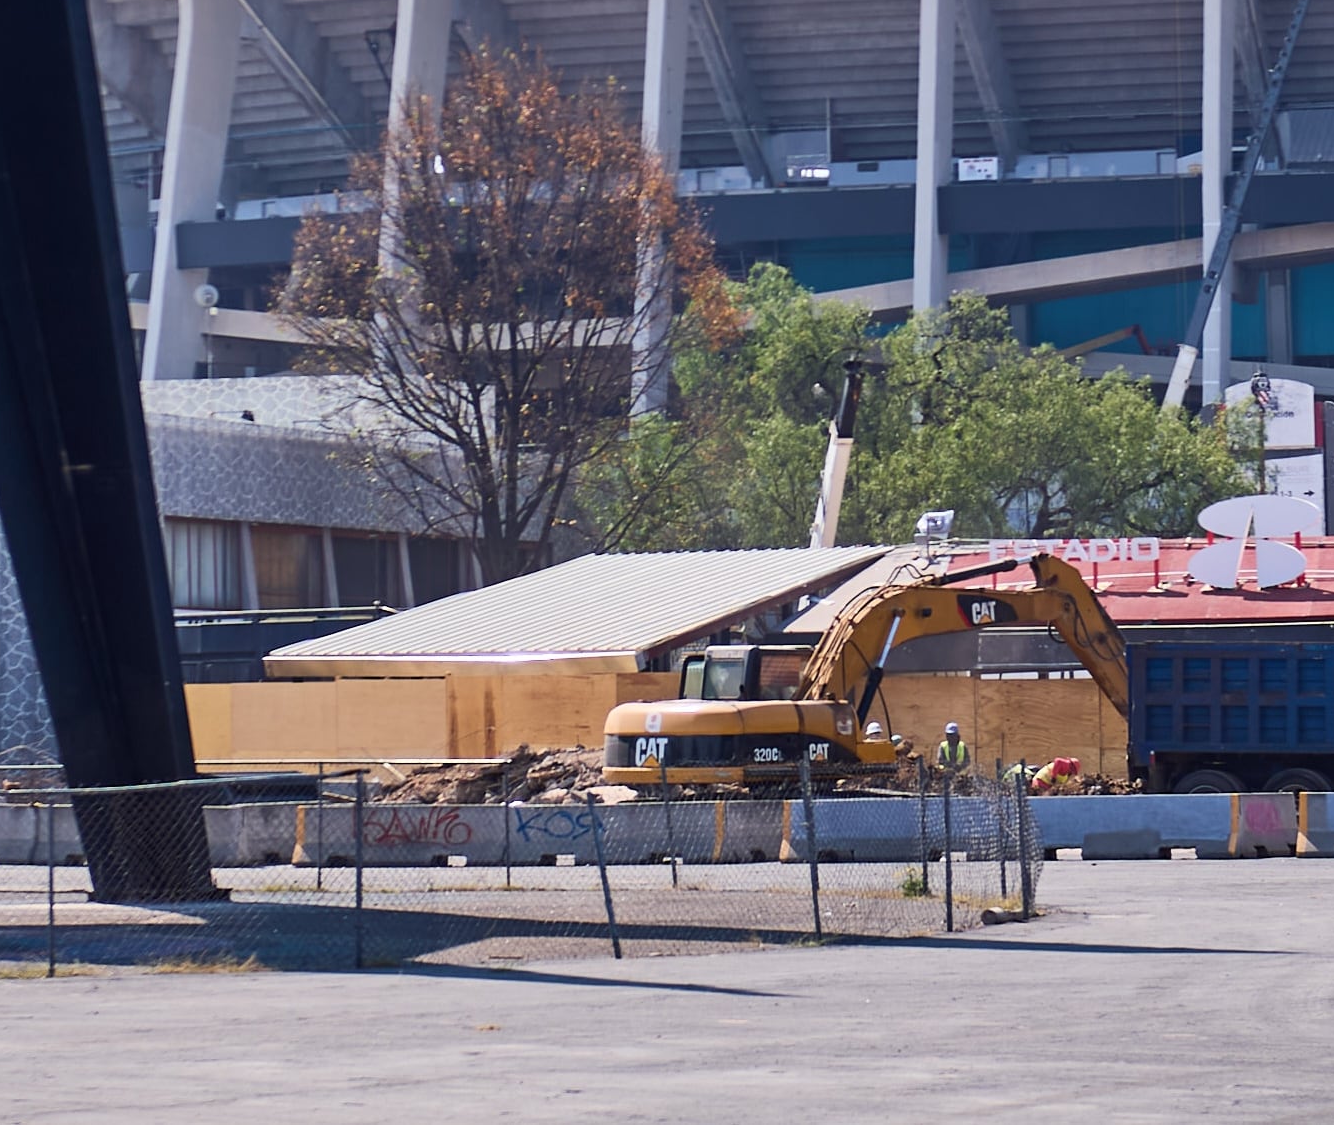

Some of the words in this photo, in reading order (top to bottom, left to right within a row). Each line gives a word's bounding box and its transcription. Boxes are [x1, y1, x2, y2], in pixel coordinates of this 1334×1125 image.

[988, 537, 1160, 563] ESTADIO
[971, 601, 996, 625] CAT
[635, 737, 668, 767] CAT
[809, 743, 829, 761] CAT
